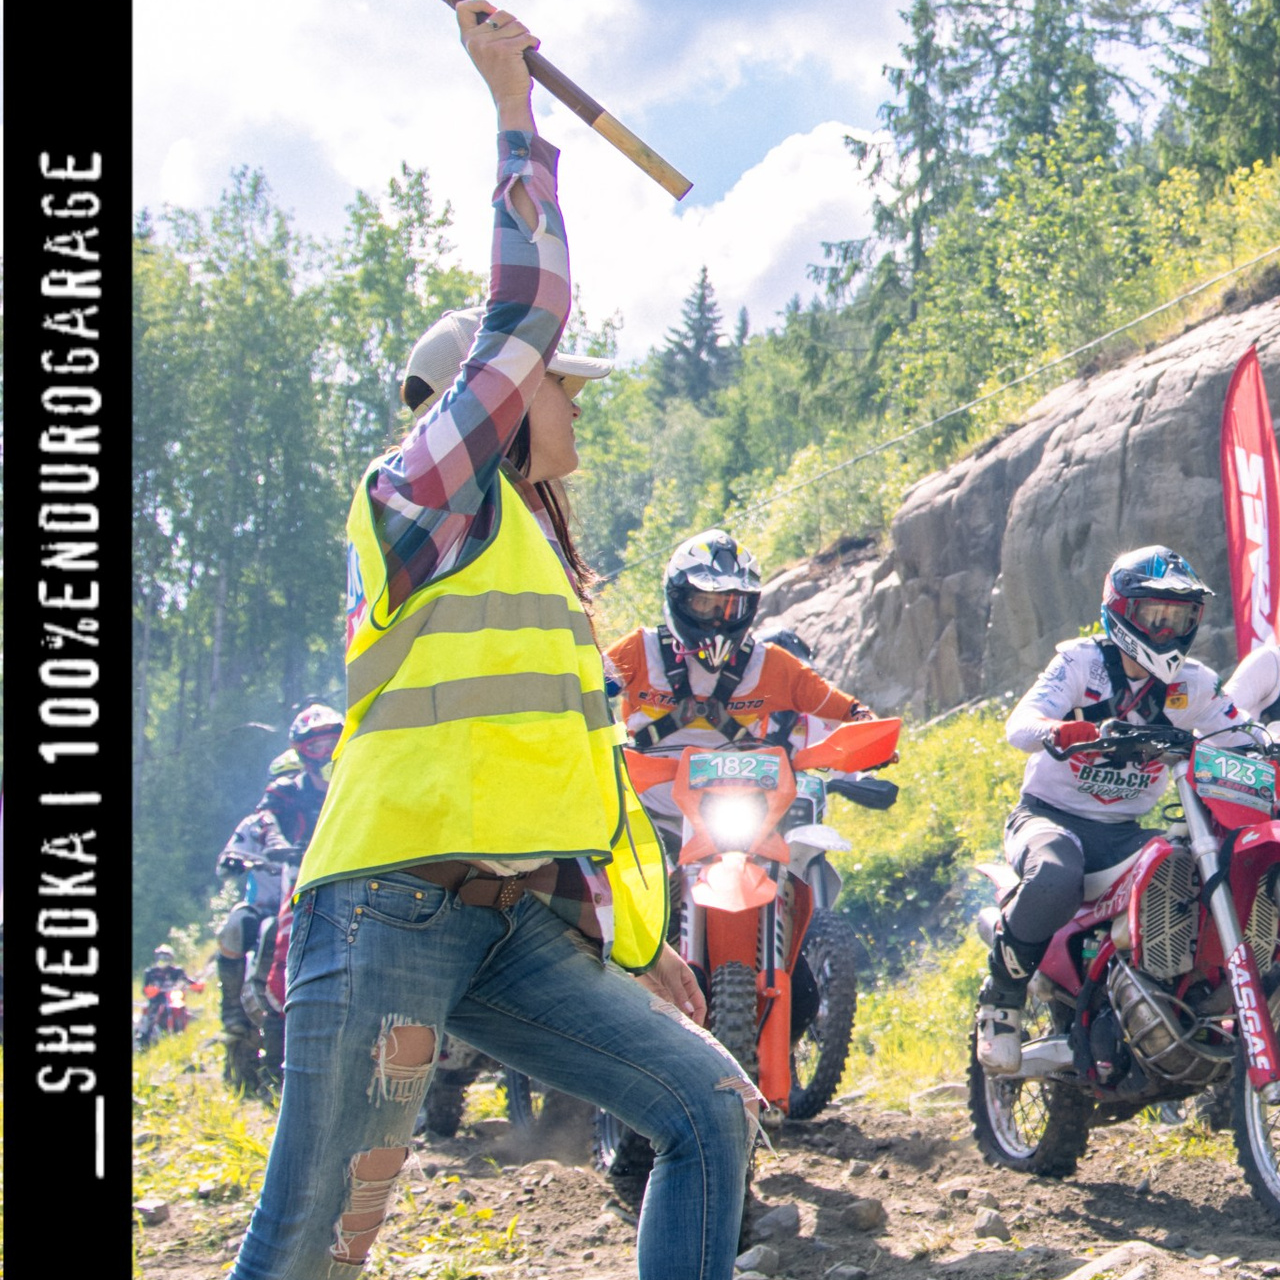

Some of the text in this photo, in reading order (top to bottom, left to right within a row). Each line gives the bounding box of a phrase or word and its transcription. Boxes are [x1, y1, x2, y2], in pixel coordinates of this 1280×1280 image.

[710, 756, 757, 777] 182
[1214, 756, 1256, 785] 123
[1078, 781, 1141, 800] ENDURO
[1217, 779, 1257, 796] KENDA
